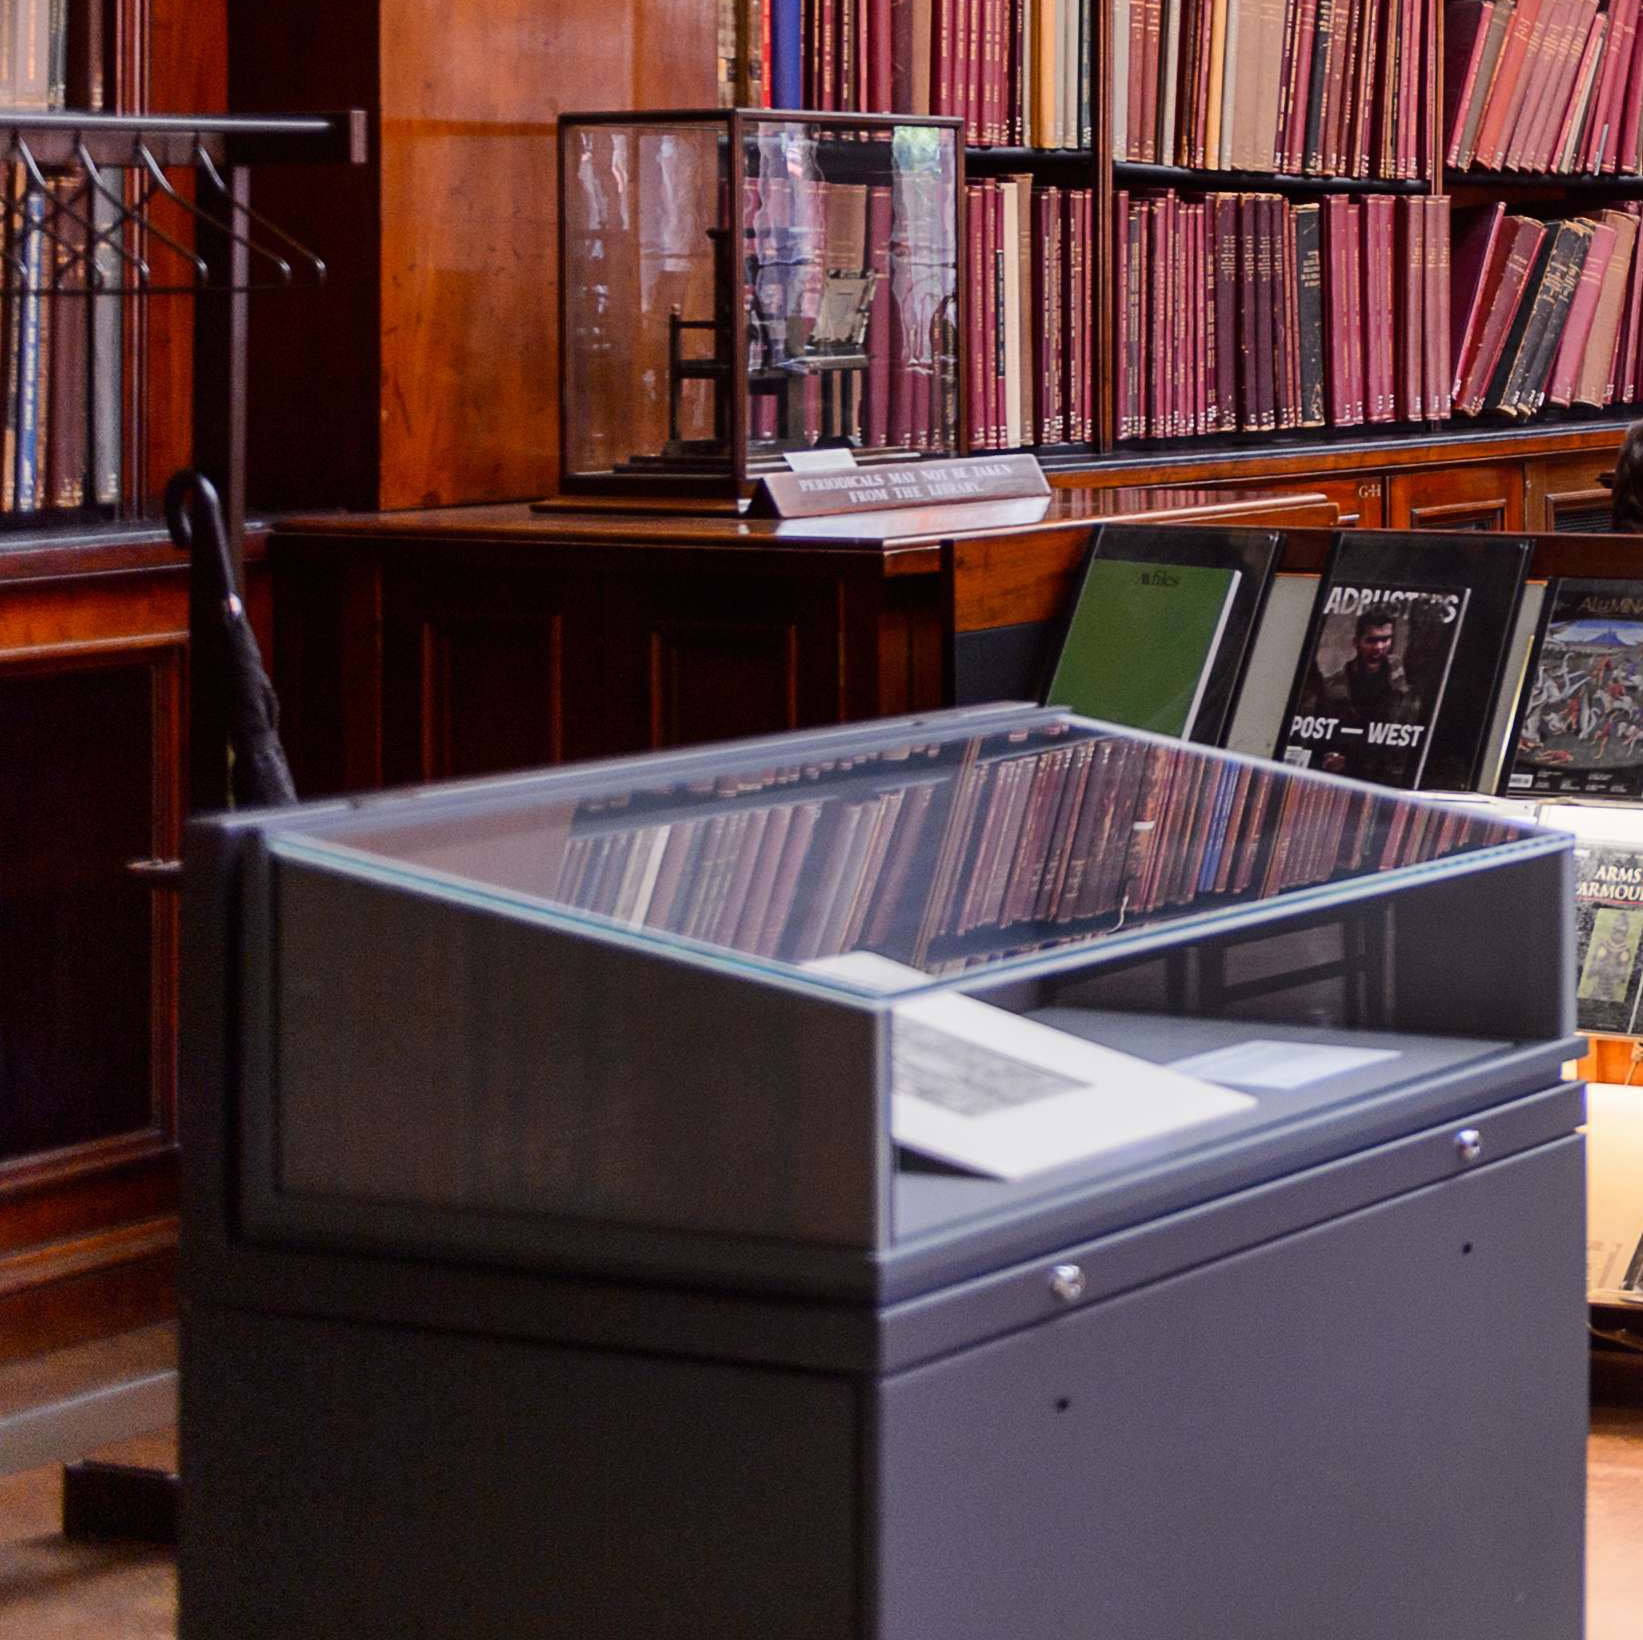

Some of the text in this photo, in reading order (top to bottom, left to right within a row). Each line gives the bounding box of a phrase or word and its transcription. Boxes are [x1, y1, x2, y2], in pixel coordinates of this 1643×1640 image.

[798, 463, 1012, 492] PERIODICALS MAY NOT BE TAKEN
[847, 487, 889, 503] FROM
[892, 484, 924, 500] THE
[1290, 716, 1339, 741] POST
[1368, 721, 1424, 747] WEST
[1595, 864, 1642, 883] ARMS
